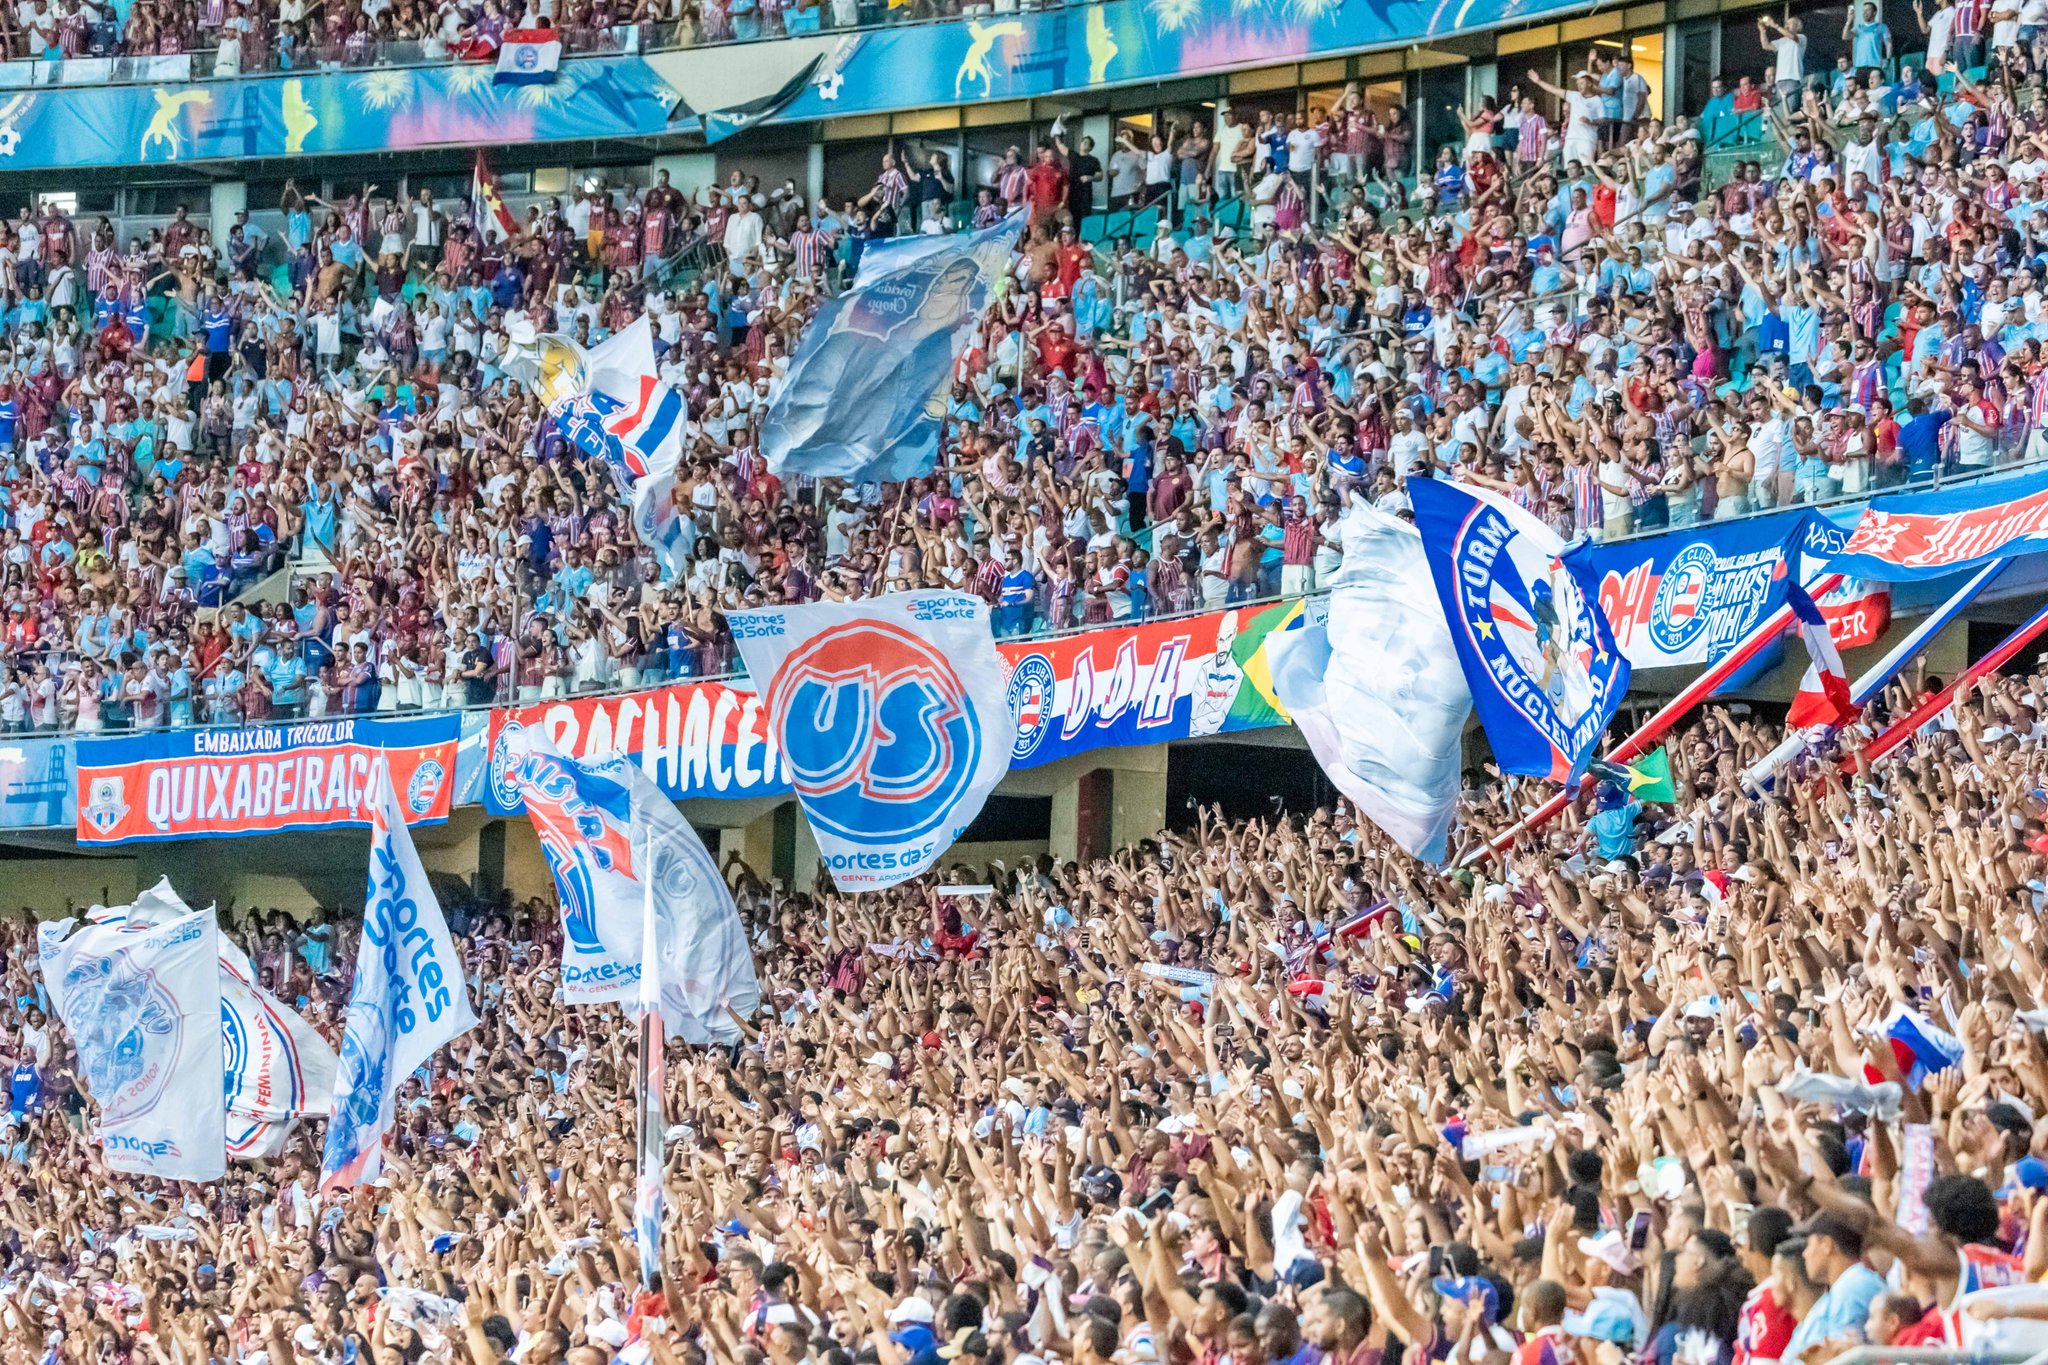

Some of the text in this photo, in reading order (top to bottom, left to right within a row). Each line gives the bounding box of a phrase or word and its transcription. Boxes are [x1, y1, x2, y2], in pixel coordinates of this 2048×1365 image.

[1805, 522, 1843, 554] NAS
[1653, 548, 1714, 627] ESPORTE CLUBE BAHIA
[907, 597, 977, 612] Esportes
[915, 608, 975, 621] da Sorte
[745, 625, 785, 638] Sorte
[1667, 632, 1683, 645] 1931
[1027, 664, 1050, 685] CLUBE
[1039, 686, 1052, 728] BAHIA
[1491, 654, 1570, 751] NÚCLEO
[194, 720, 356, 753] EMBAIXADA TRICOLOR
[1017, 738, 1031, 750] 1931
[841, 874, 876, 882] GENTE
[588, 984, 618, 993] GENTE
